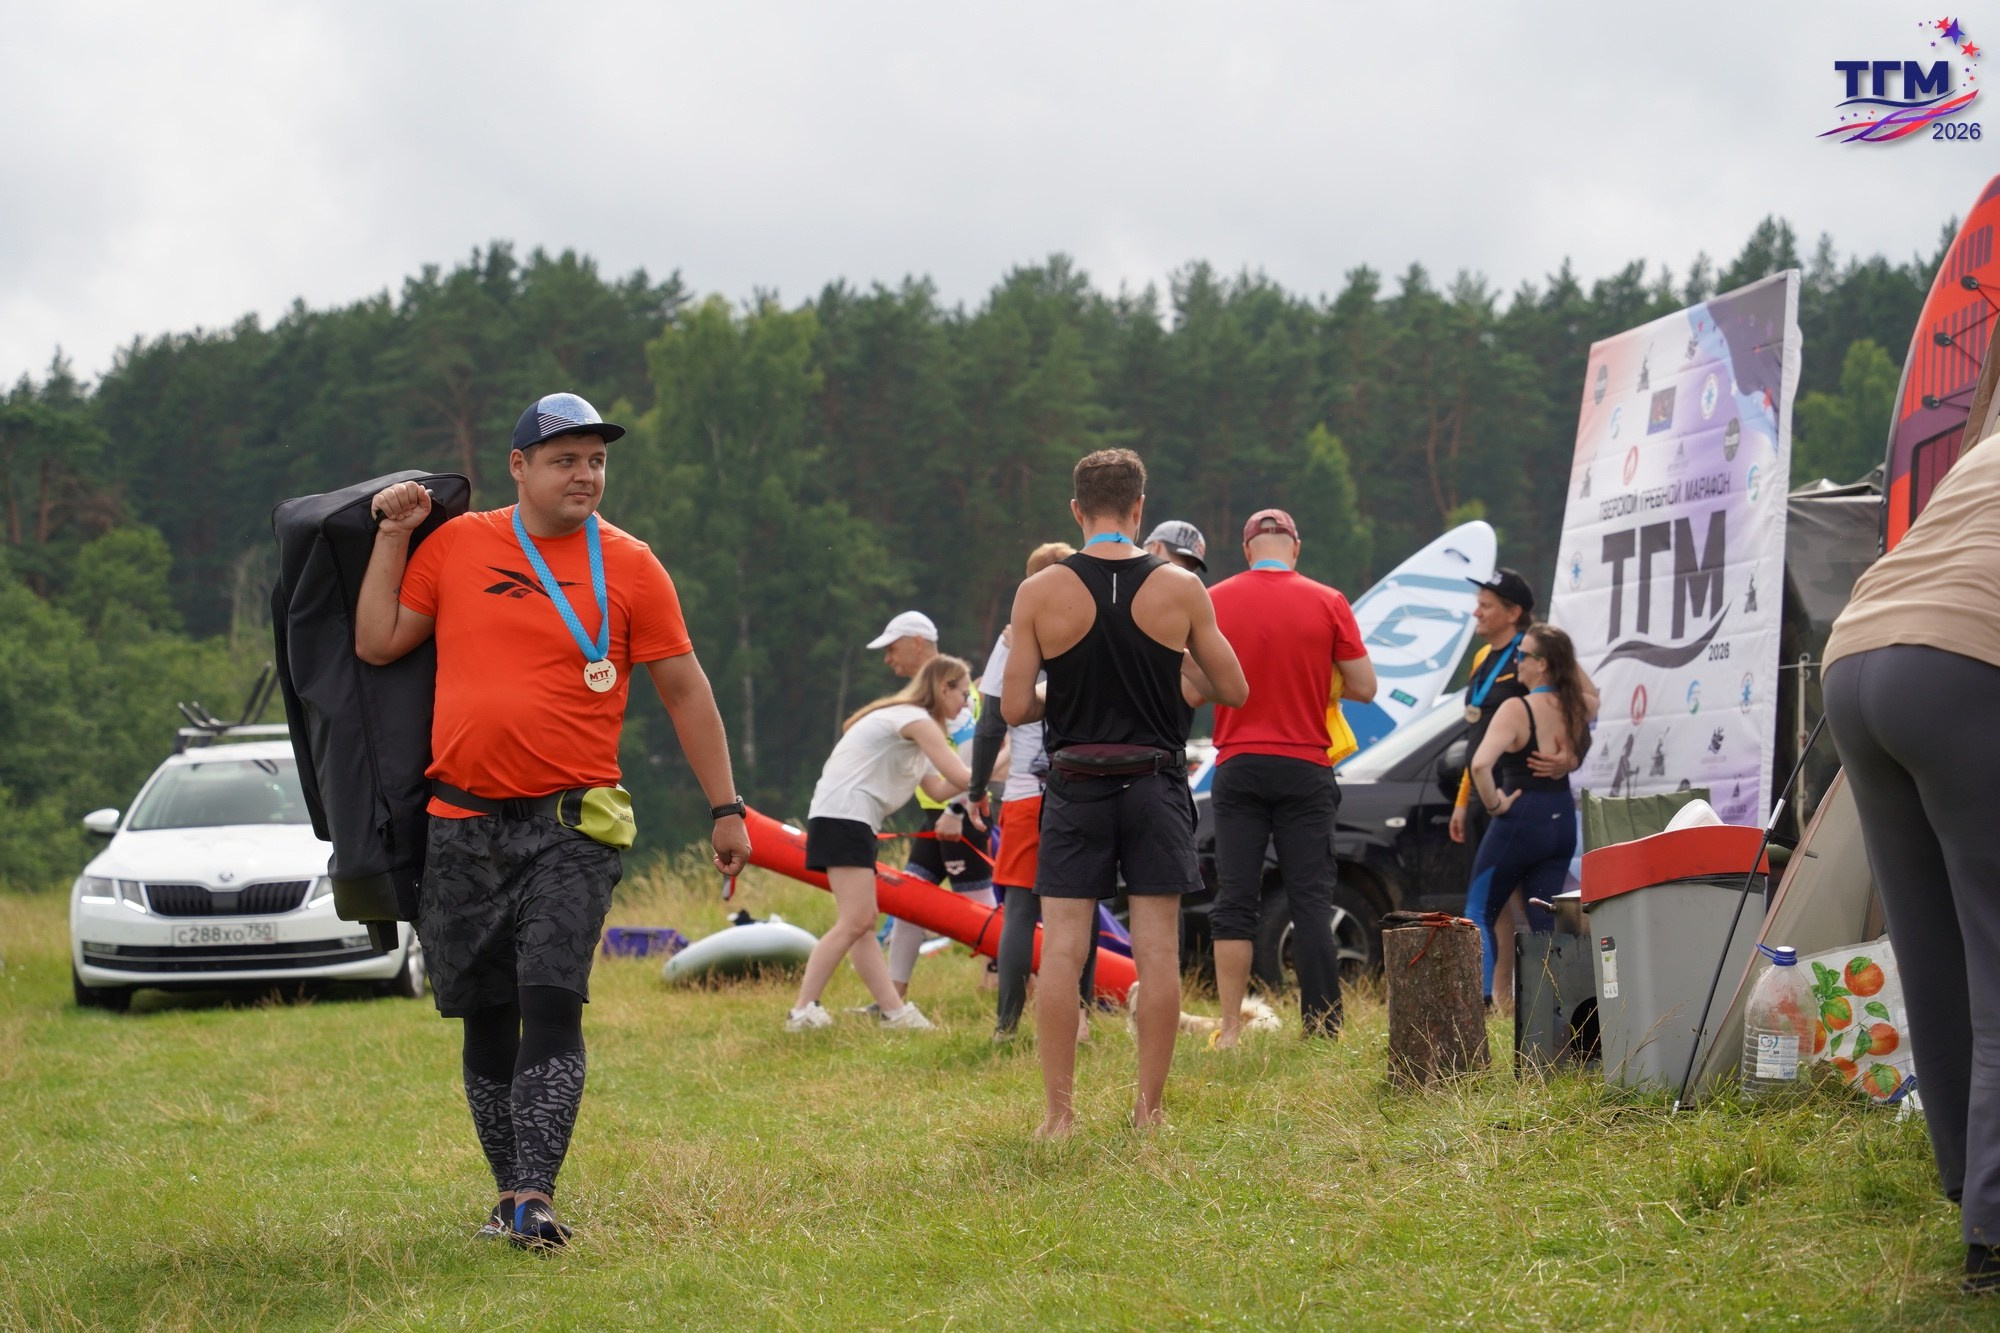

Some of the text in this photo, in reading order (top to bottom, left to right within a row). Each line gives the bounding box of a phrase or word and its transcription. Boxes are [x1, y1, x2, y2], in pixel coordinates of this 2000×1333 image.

[1684, 472, 1731, 502] МАРАФОН
[1602, 510, 1726, 645] ТГМ
[1708, 642, 1730, 661] 2026
[247, 922, 272, 938] 750
